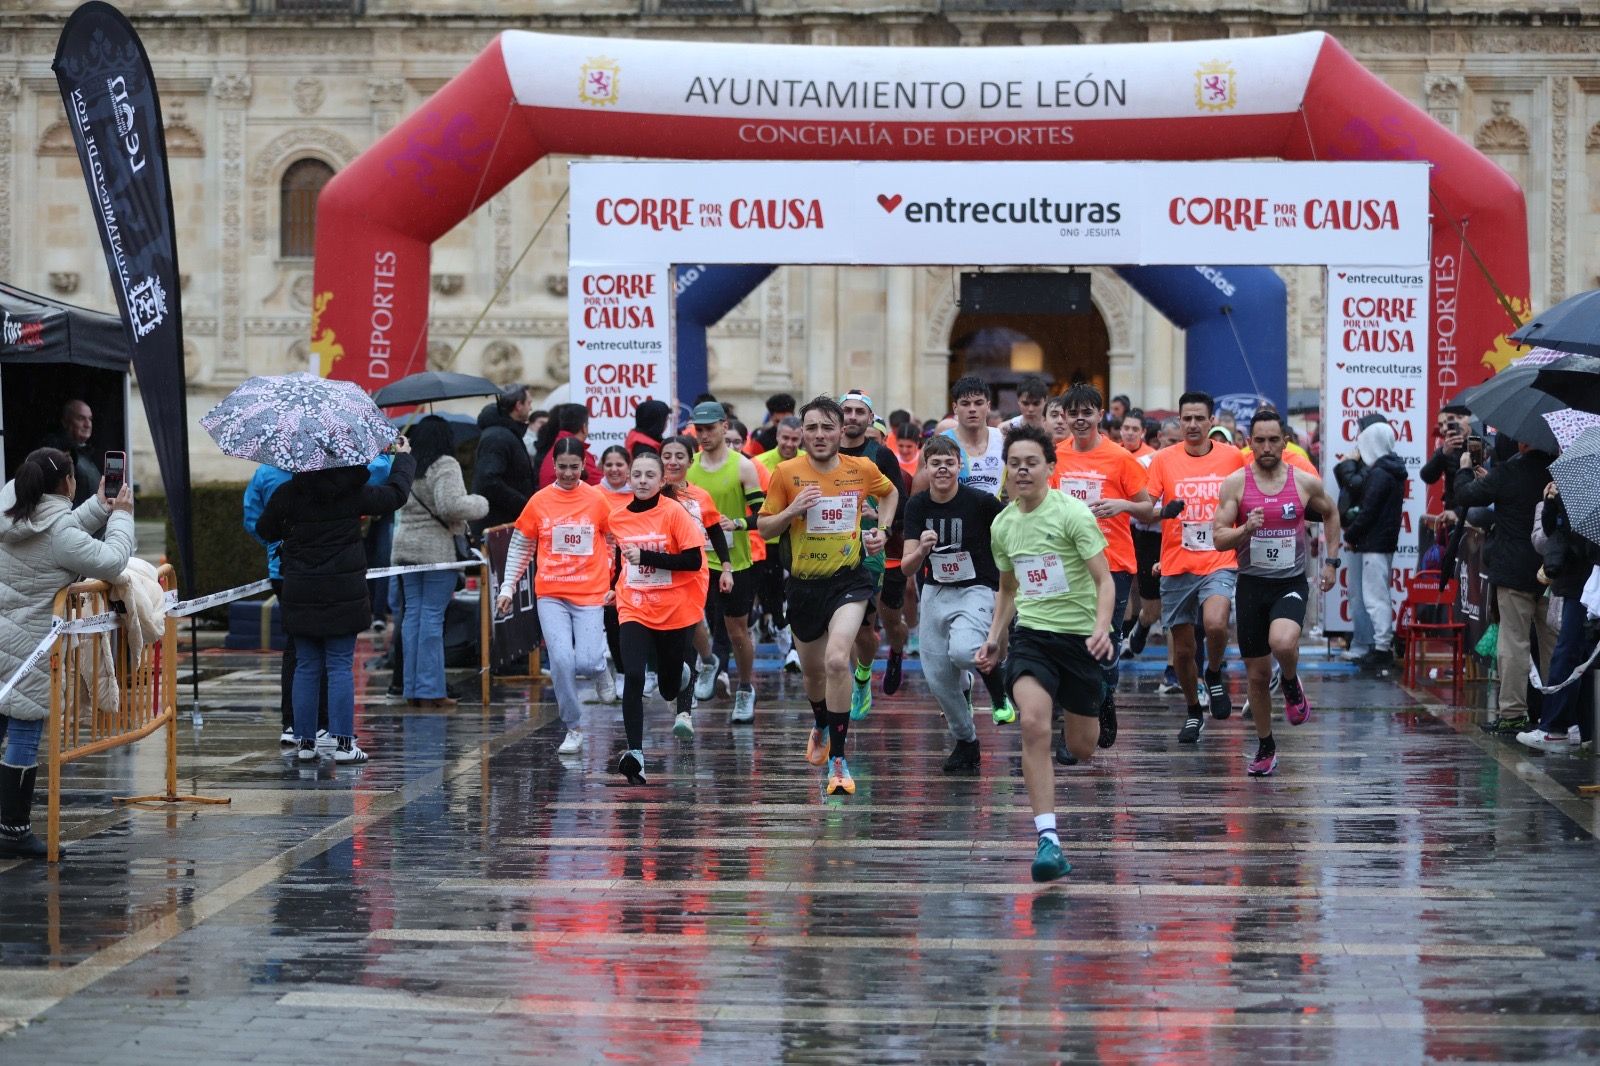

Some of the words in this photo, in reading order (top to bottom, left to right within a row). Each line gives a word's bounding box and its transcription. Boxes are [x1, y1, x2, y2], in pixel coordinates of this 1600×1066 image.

[685, 76, 966, 109] AYUNTAMIENTO
[980, 81, 1023, 109] DE
[1037, 72, 1126, 108] LEÓN
[738, 122, 893, 146] CONCEJALÍA
[903, 127, 936, 146] DE
[946, 125, 1074, 146] DEPORTES
[596, 197, 695, 232] CORRE
[699, 203, 723, 217] POR
[729, 198, 824, 230] CAUSA
[905, 197, 1121, 224] entreculturas
[1168, 197, 1269, 232] CORRE
[1273, 203, 1298, 217] POR
[1303, 198, 1400, 231] CAUSA
[700, 216, 723, 228] UNA
[1274, 216, 1297, 228] UNA
[1059, 228, 1080, 238] ONG
[1084, 228, 1121, 238] JESUITA
[1346, 272, 1424, 285] entreculturas
[582, 273, 657, 300] CORRE
[583, 296, 602, 307] POR
[603, 296, 620, 306] UNA
[368, 250, 397, 379] DEPORTES
[1342, 296, 1418, 323] CORRE
[583, 305, 655, 330] CAUSA
[1343, 319, 1362, 330] POR
[1363, 318, 1380, 329] UNA
[1435, 254, 1458, 387] DEPORTES
[586, 339, 662, 351] entreculturas
[1342, 328, 1415, 353] CAUSA
[1345, 362, 1422, 374] entreculturas
[584, 363, 659, 389] CORRE
[585, 385, 603, 396] POR
[604, 385, 622, 394] UNA
[1341, 386, 1416, 413] CORRE
[586, 394, 653, 419] CAUS
[1342, 408, 1360, 419] POR
[1070, 489, 1087, 500] 520
[821, 508, 843, 521] 596
[1196, 530, 1206, 541] 21
[1255, 527, 1297, 537] isiorama
[564, 533, 582, 545] 603
[1266, 548, 1279, 559] 52
[941, 562, 960, 573] 628
[1027, 568, 1048, 584] 554
